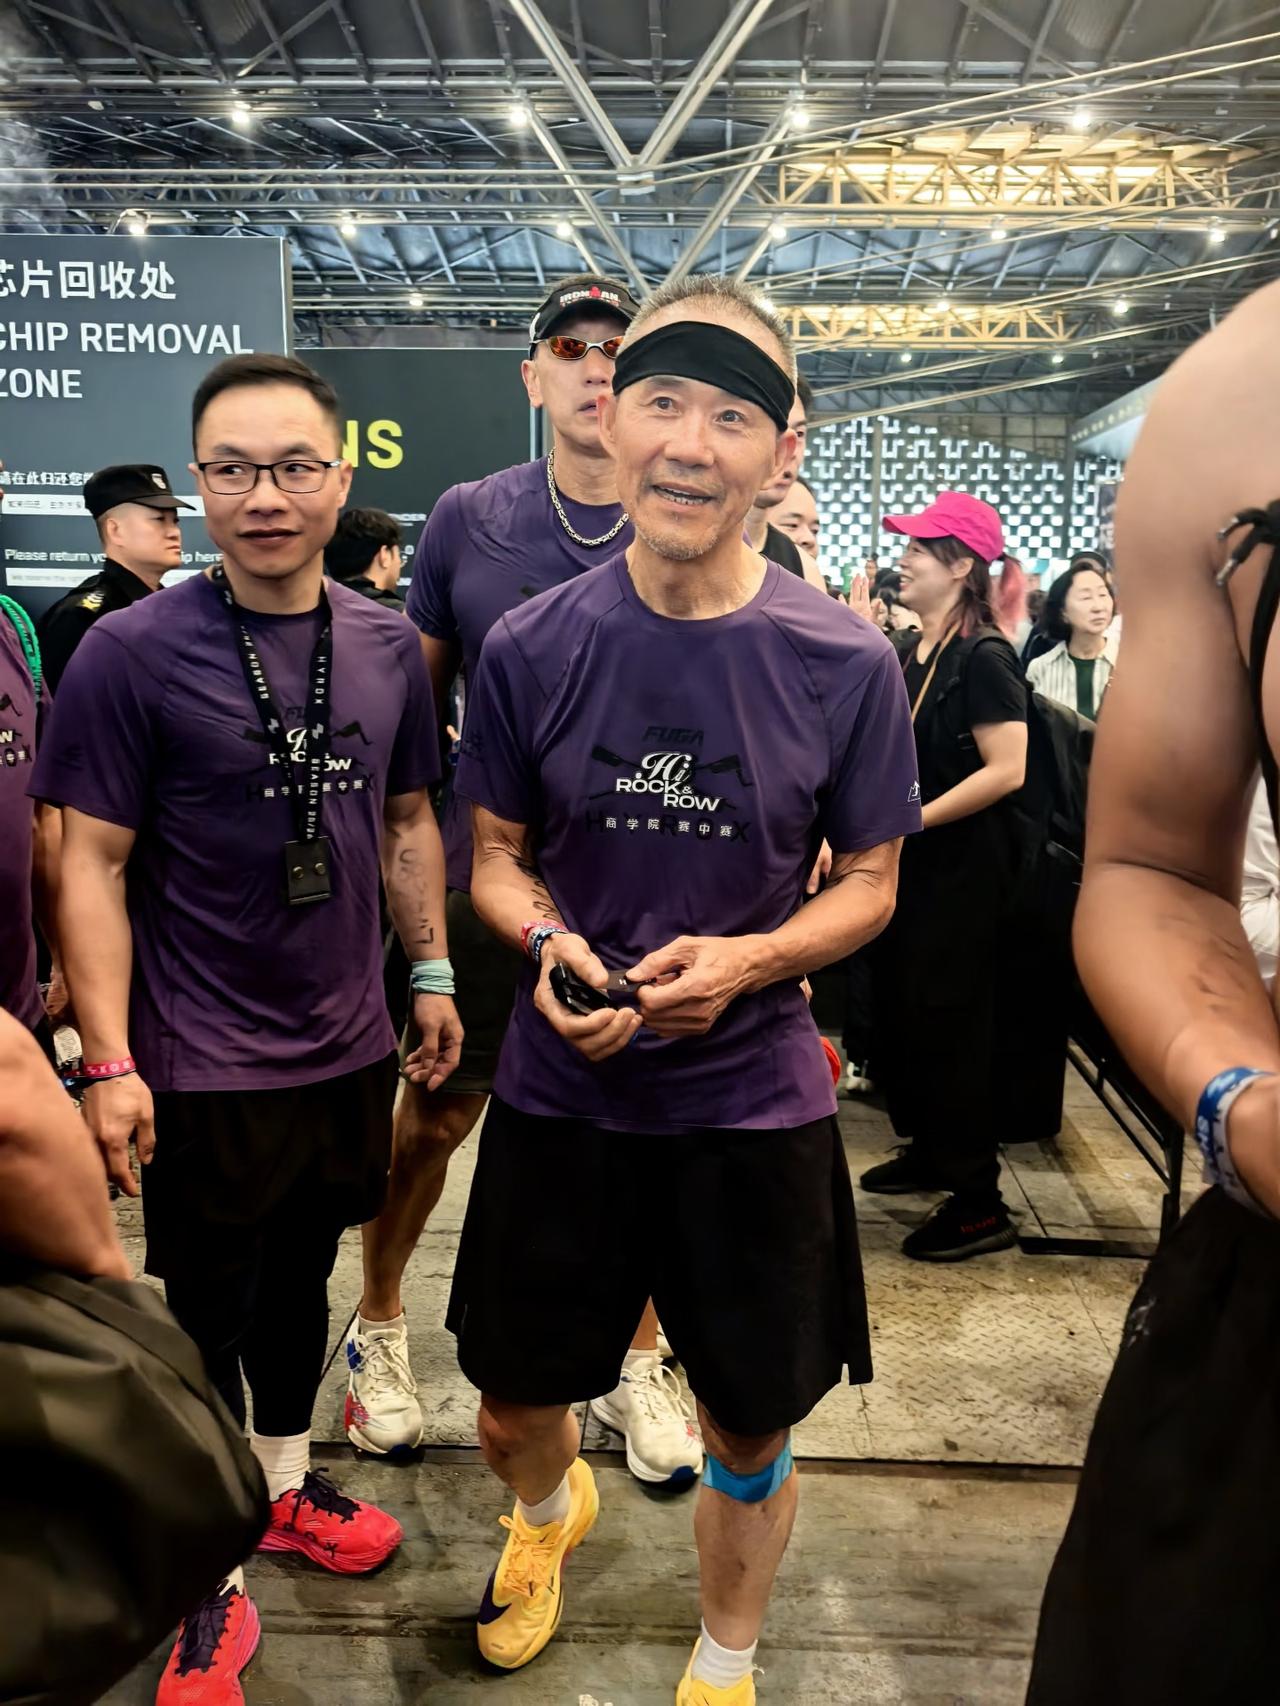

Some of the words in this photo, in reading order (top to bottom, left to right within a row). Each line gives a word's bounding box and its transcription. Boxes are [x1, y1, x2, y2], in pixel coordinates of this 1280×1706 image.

[80, 322, 254, 354] REMOVAL
[5, 548, 48, 561] Please
[49, 552, 90, 561] return
[314, 656, 327, 705] HYROX
[616, 777, 682, 795] ROCK
[663, 793, 721, 811] ROW
